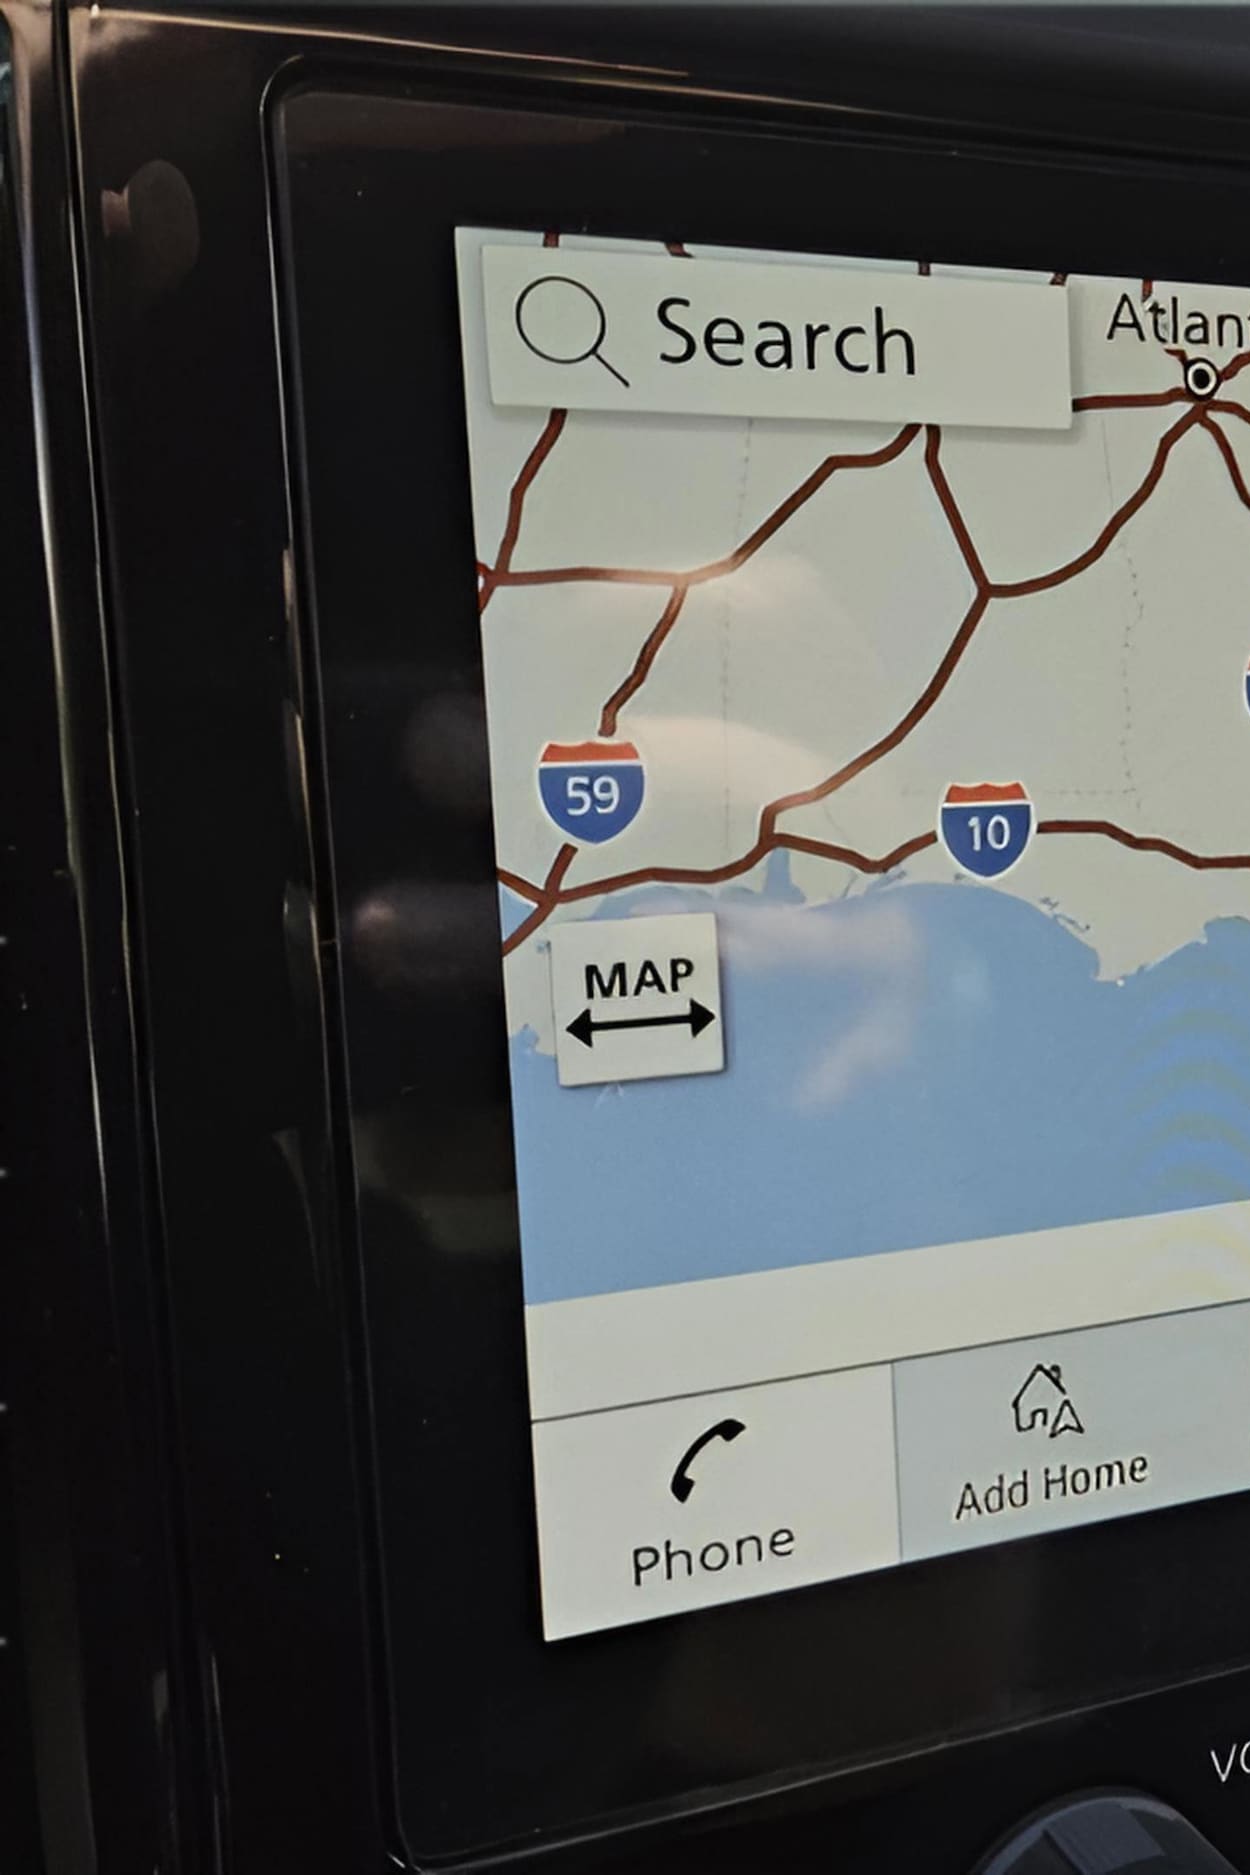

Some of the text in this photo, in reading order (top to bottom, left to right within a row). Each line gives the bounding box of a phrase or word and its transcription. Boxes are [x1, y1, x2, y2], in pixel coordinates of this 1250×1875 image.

[656, 297, 917, 377] Search
[566, 775, 620, 816] 59
[969, 814, 1011, 852] 10
[583, 957, 695, 1000] MAP
[955, 1453, 1149, 1521] Add Home
[632, 1524, 796, 1587] Phone
